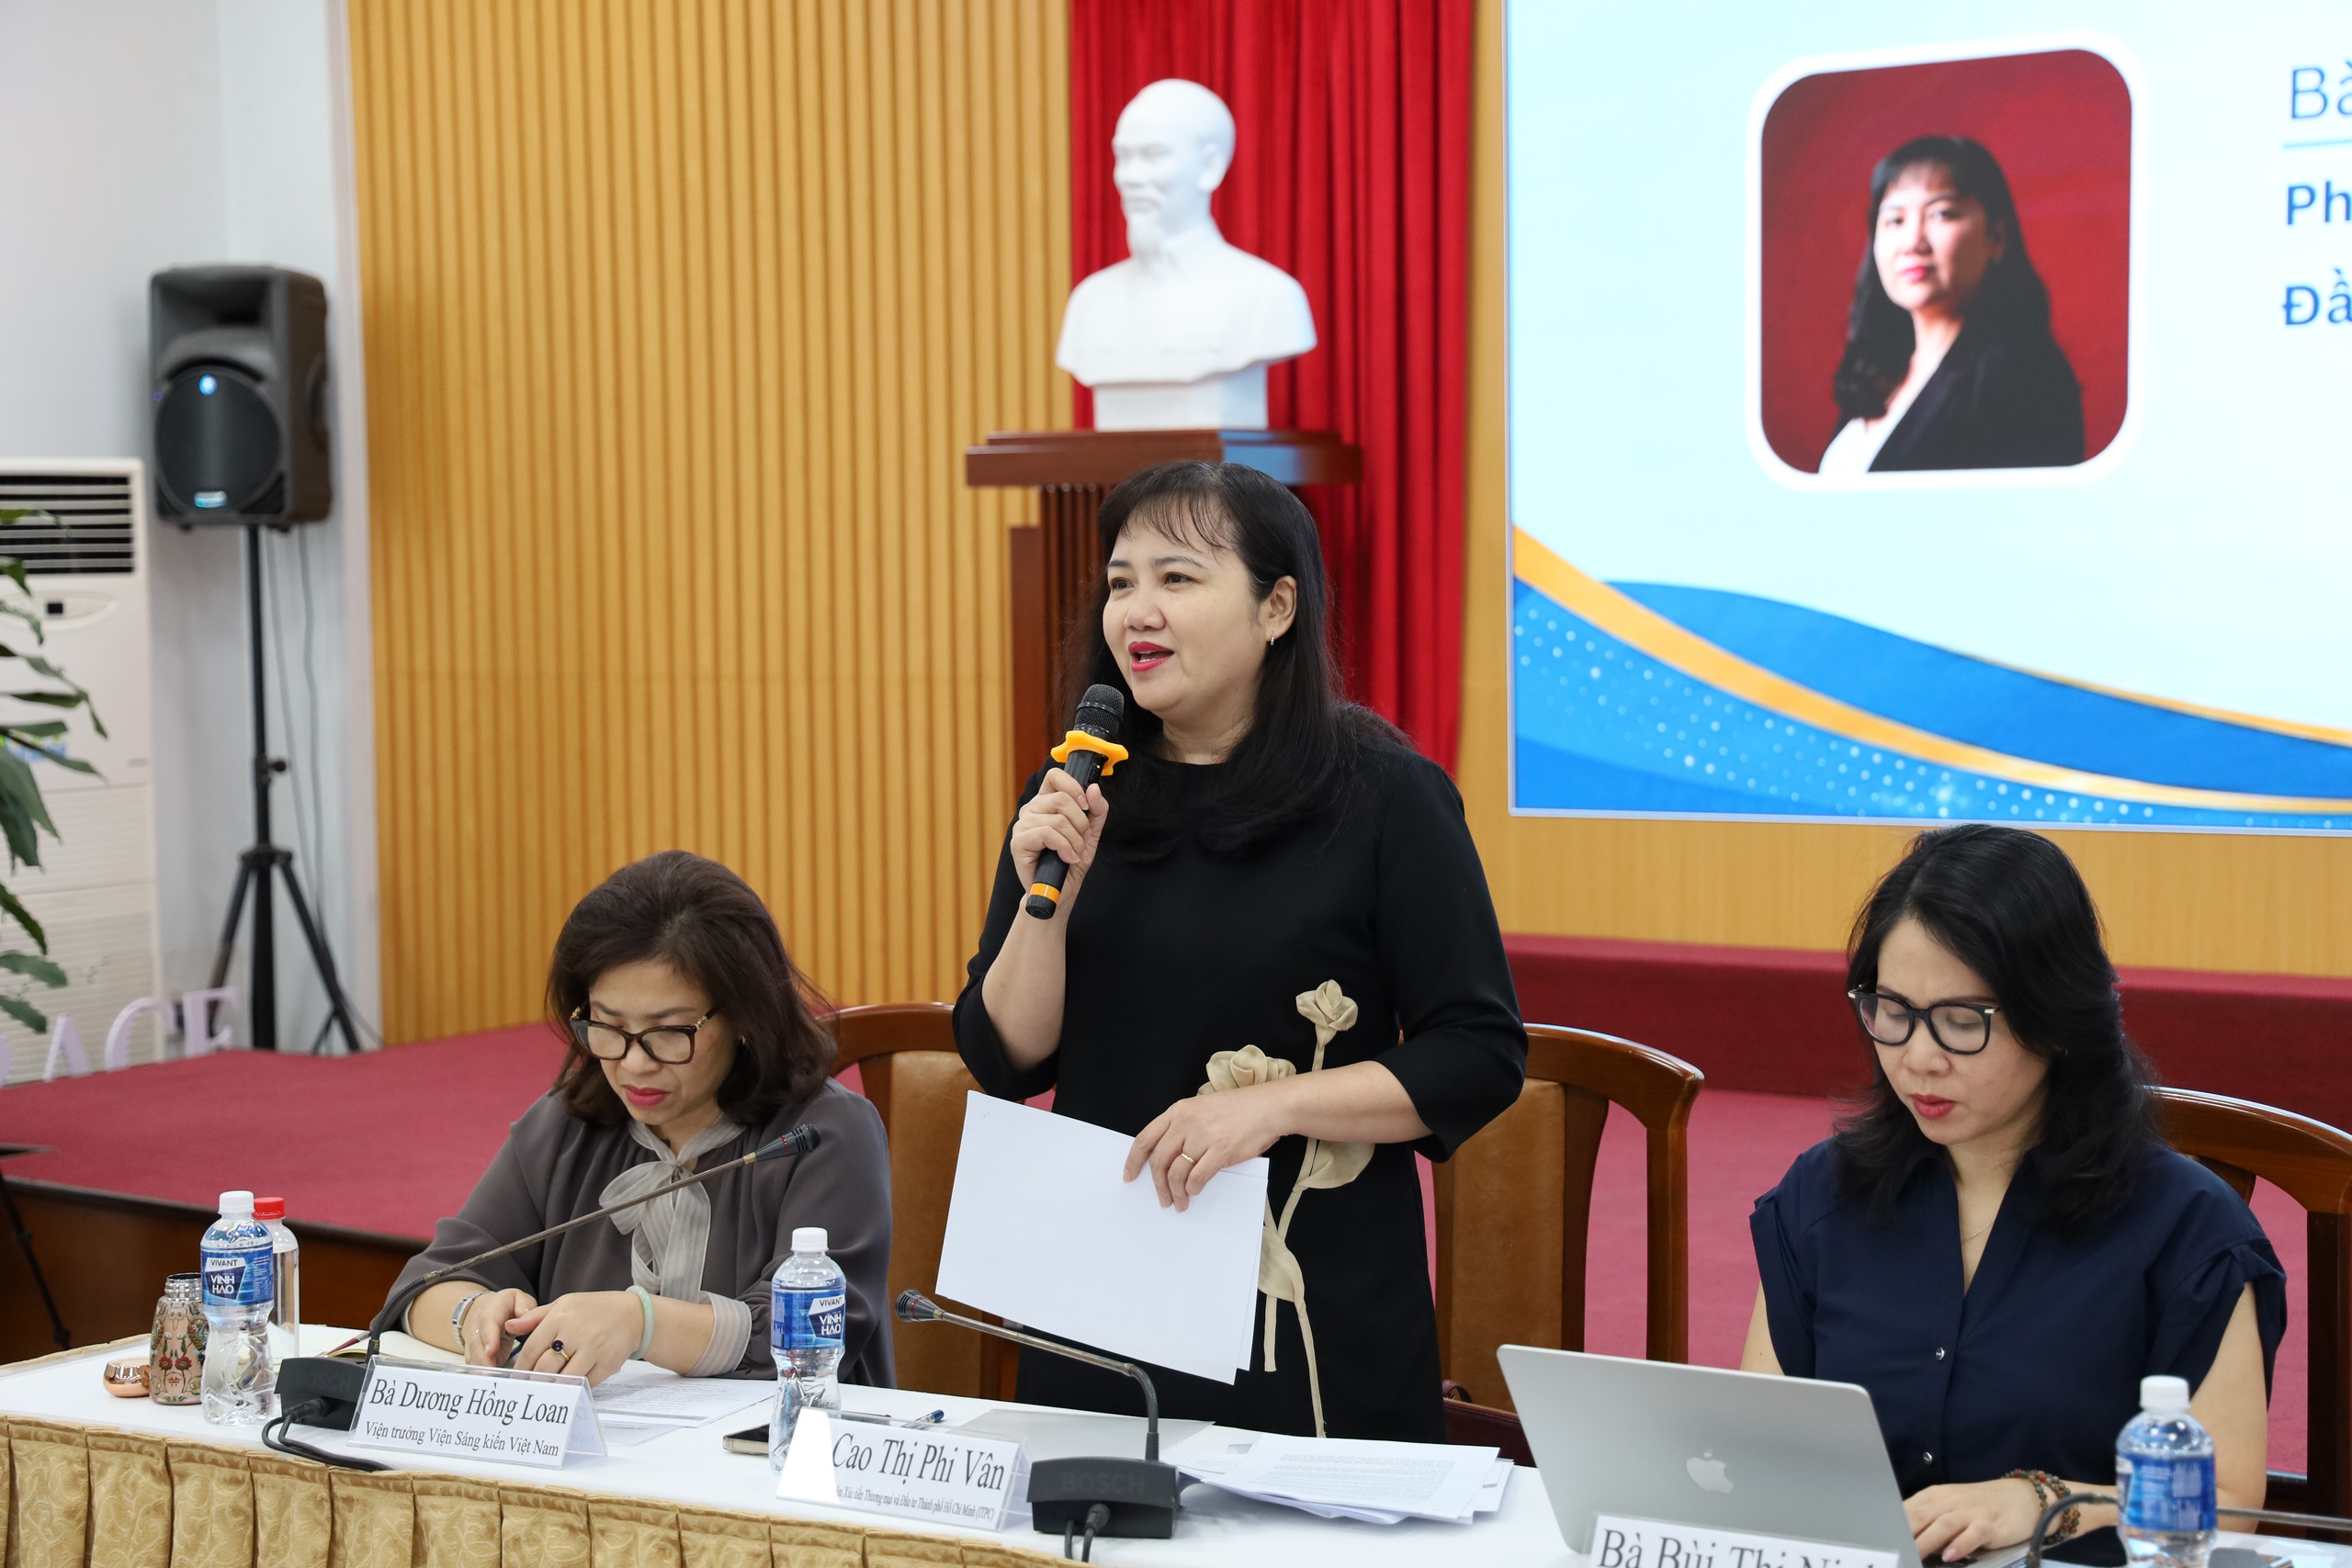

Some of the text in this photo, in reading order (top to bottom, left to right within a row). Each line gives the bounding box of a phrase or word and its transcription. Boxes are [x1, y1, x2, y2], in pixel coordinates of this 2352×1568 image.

[820, 1297, 842, 1306] VIVANT
[369, 1379, 396, 1405] Bà
[398, 1382, 463, 1420] Dương
[465, 1382, 518, 1426] Hồng
[520, 1393, 569, 1424] Loan
[367, 1421, 560, 1456] Viện trưởng Viện Sáng kiến Việt Nam
[832, 1433, 1005, 1490] Cao Thị Phi Vân
[1060, 1472, 1145, 1495] BOSCH
[1597, 1529, 1643, 1568] Bà
